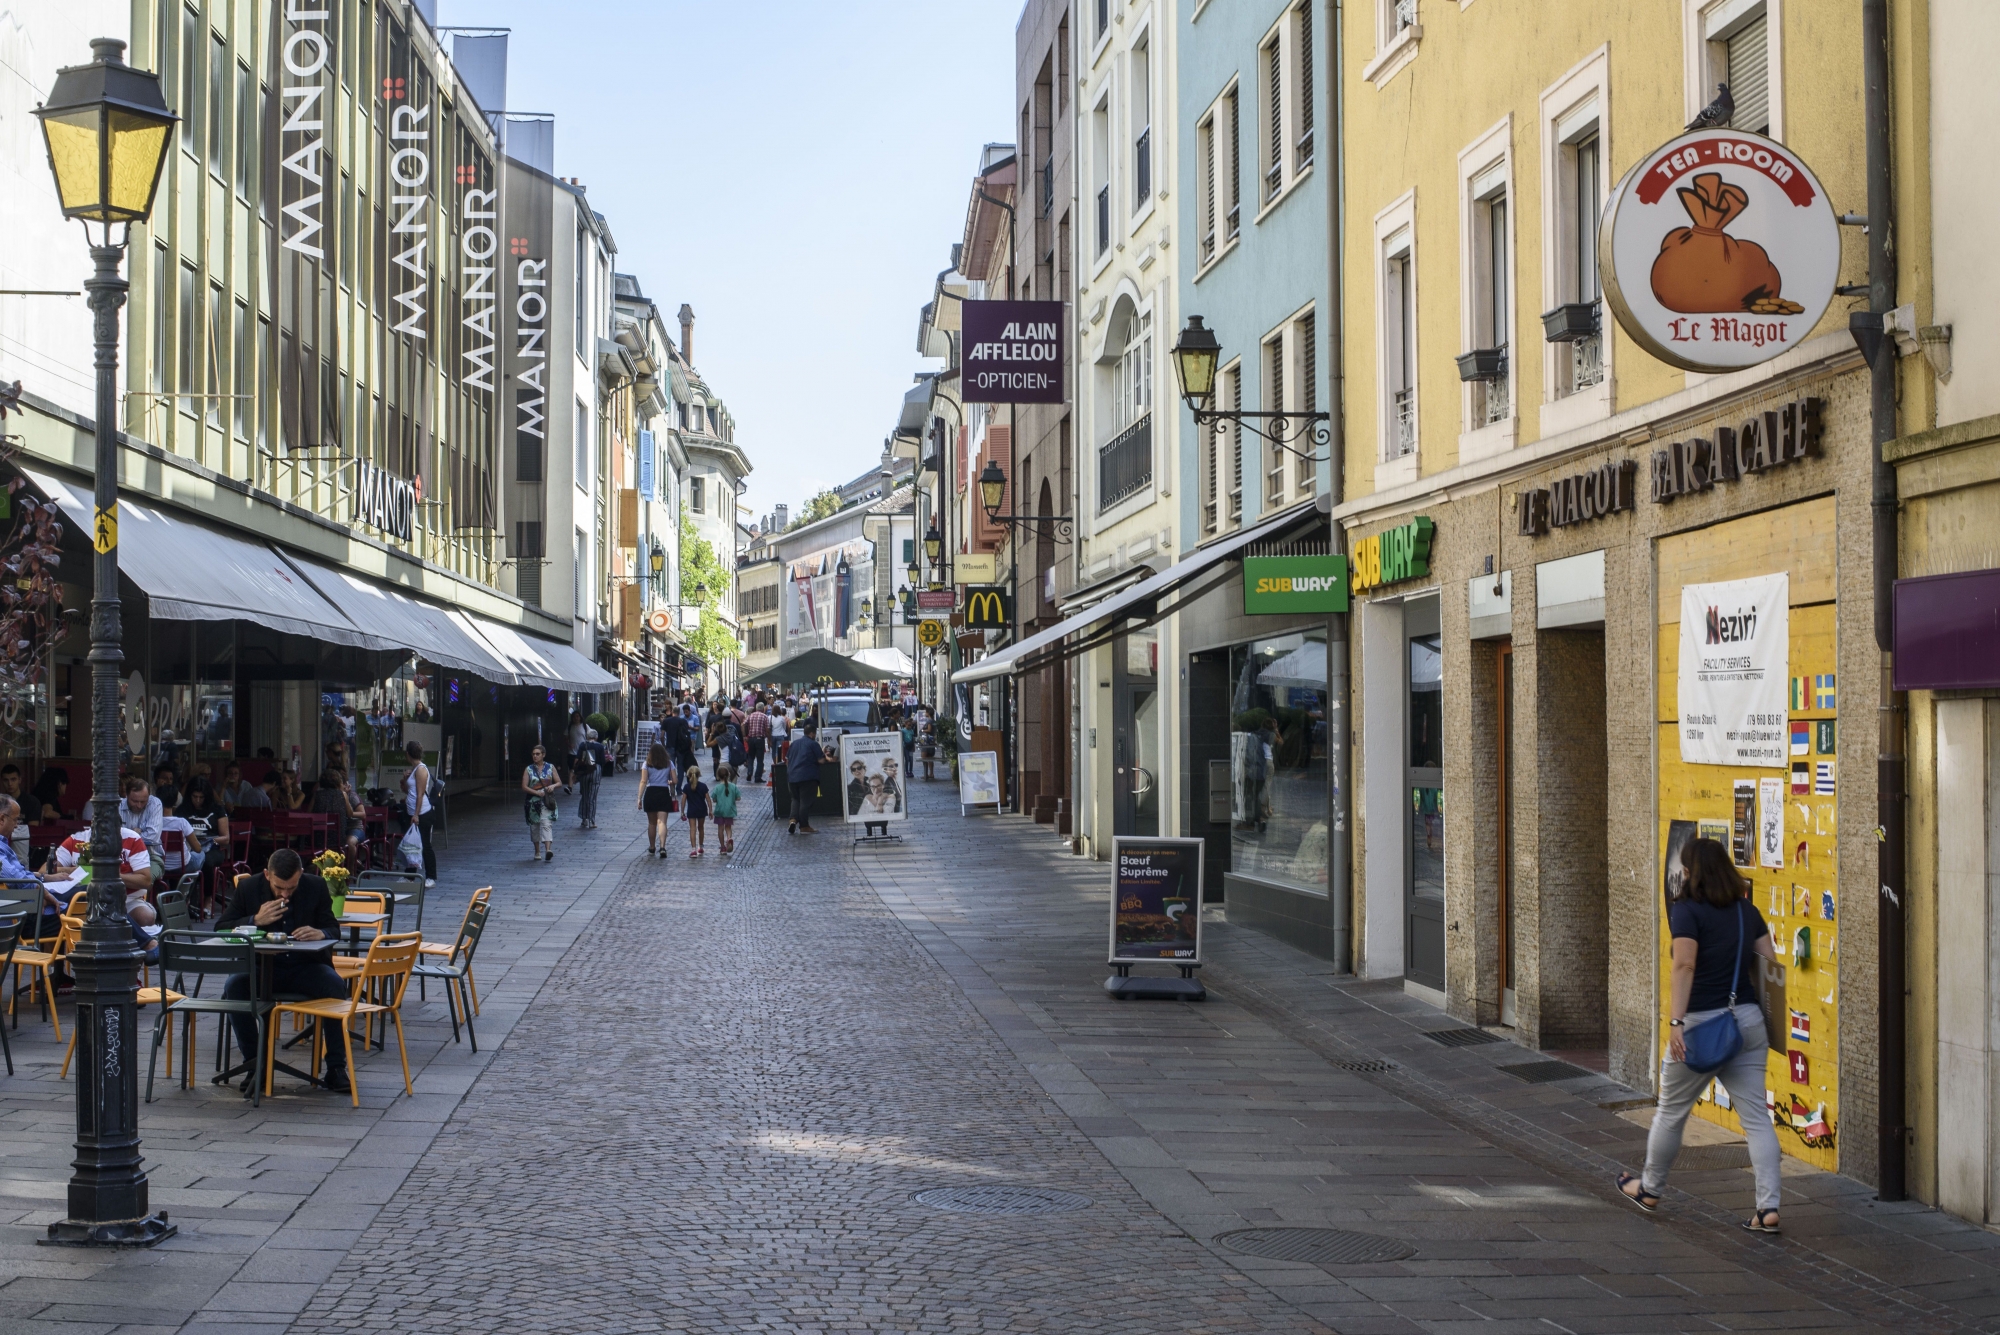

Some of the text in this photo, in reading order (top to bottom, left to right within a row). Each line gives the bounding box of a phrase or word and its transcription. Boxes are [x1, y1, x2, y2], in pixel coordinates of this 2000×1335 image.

[1655, 146, 1700, 180] TEA
[1718, 141, 1794, 185] ROOM
[391, 103, 430, 339] MANOR
[462, 187, 498, 393] MANOR
[1000, 322, 1057, 340] ALAIN
[1667, 317, 1788, 348] Le Magot
[516, 257, 547, 440] MANOR
[968, 342, 1057, 361] AFFLELOU
[1518, 397, 1821, 536] LE MAGOT BAR A CAFE
[355, 457, 417, 541] MANOR
[1352, 516, 1432, 594] SUBWAY
[1255, 575, 1338, 594] SUBWAY
[1705, 604, 1757, 645] Neziri
[1703, 656, 1751, 670] FACILITY SERVICES
[1767, 714, 1775, 725] 83
[1120, 856, 1151, 866] Bœuf
[1120, 867, 1169, 878] Suprême
[1120, 899, 1143, 911] BBQ
[1159, 949, 1194, 957] SUBWAY
